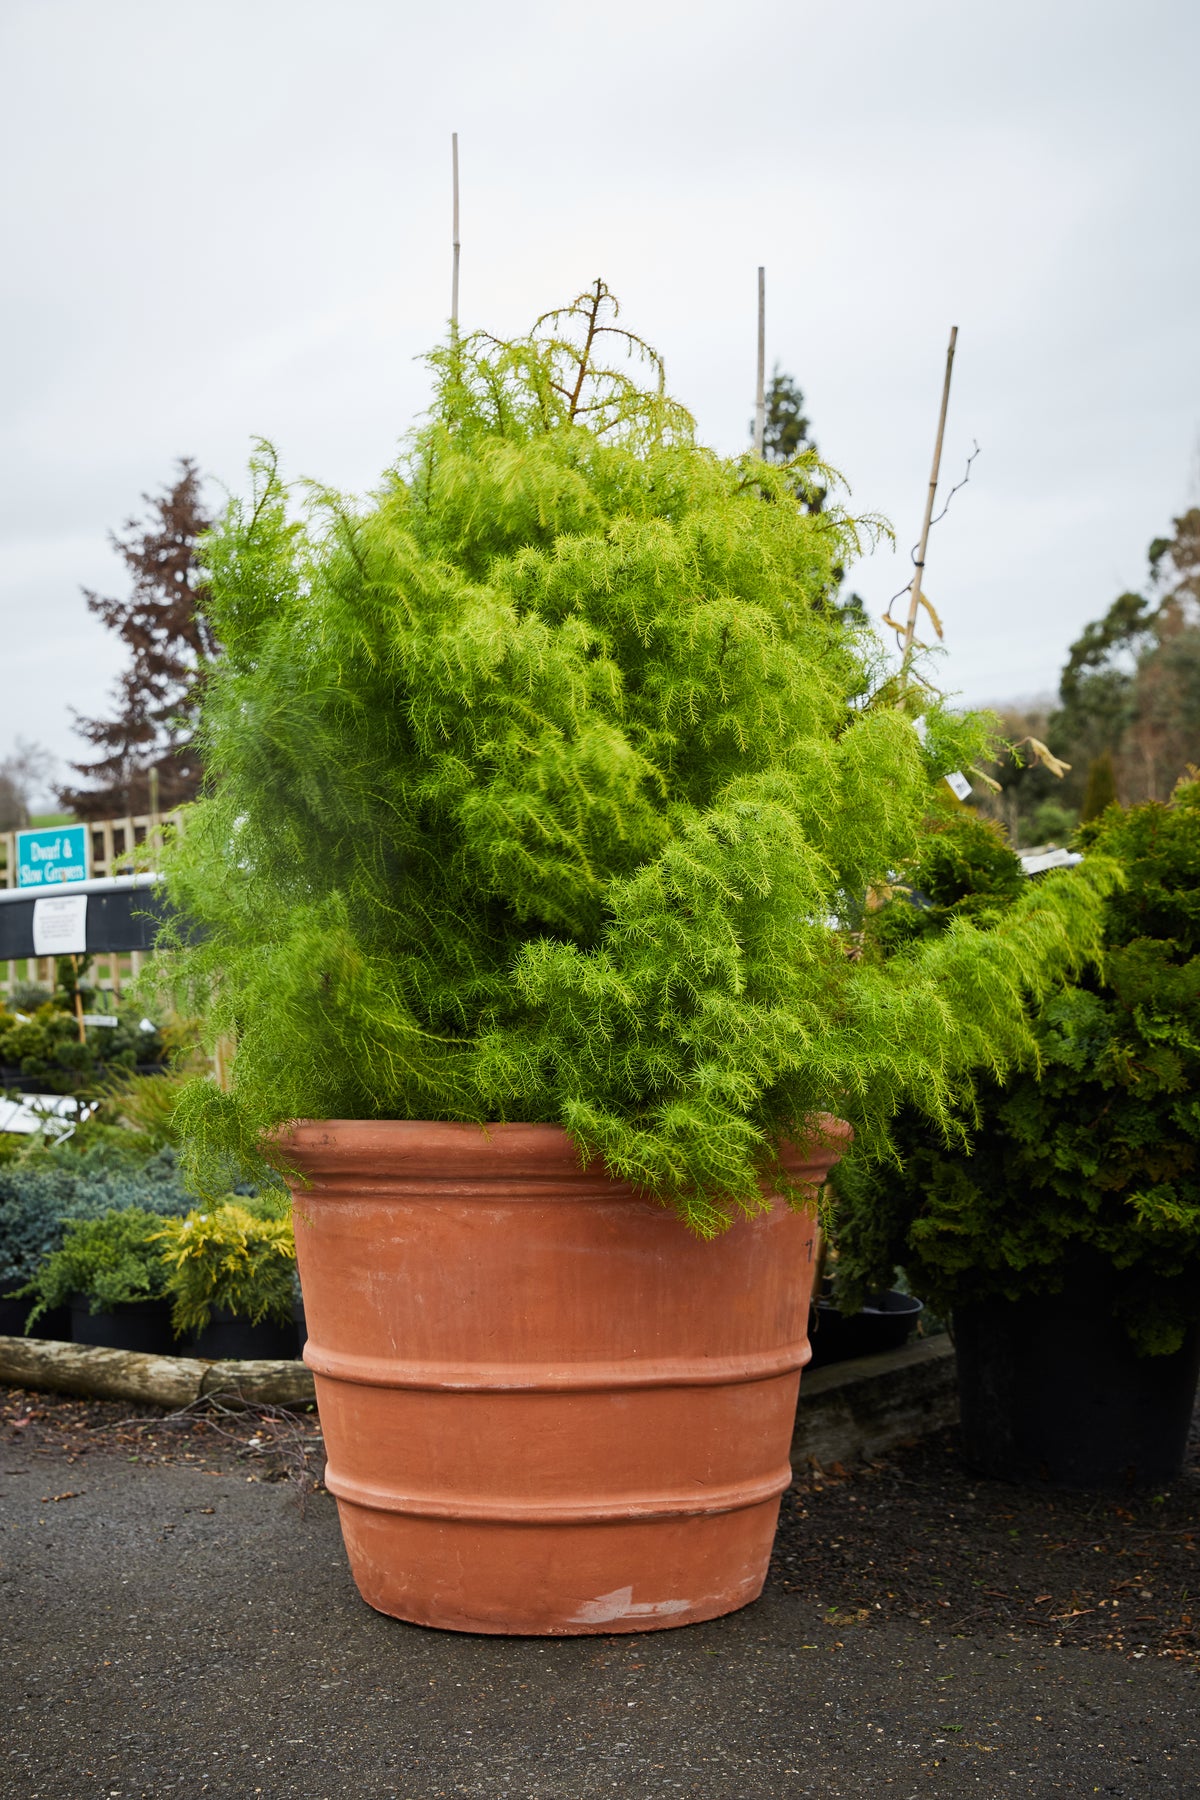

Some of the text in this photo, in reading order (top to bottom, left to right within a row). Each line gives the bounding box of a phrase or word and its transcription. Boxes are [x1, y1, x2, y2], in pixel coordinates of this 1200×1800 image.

[30, 838, 73, 862] Dwarf &
[21, 861, 84, 884] Slow Growers
